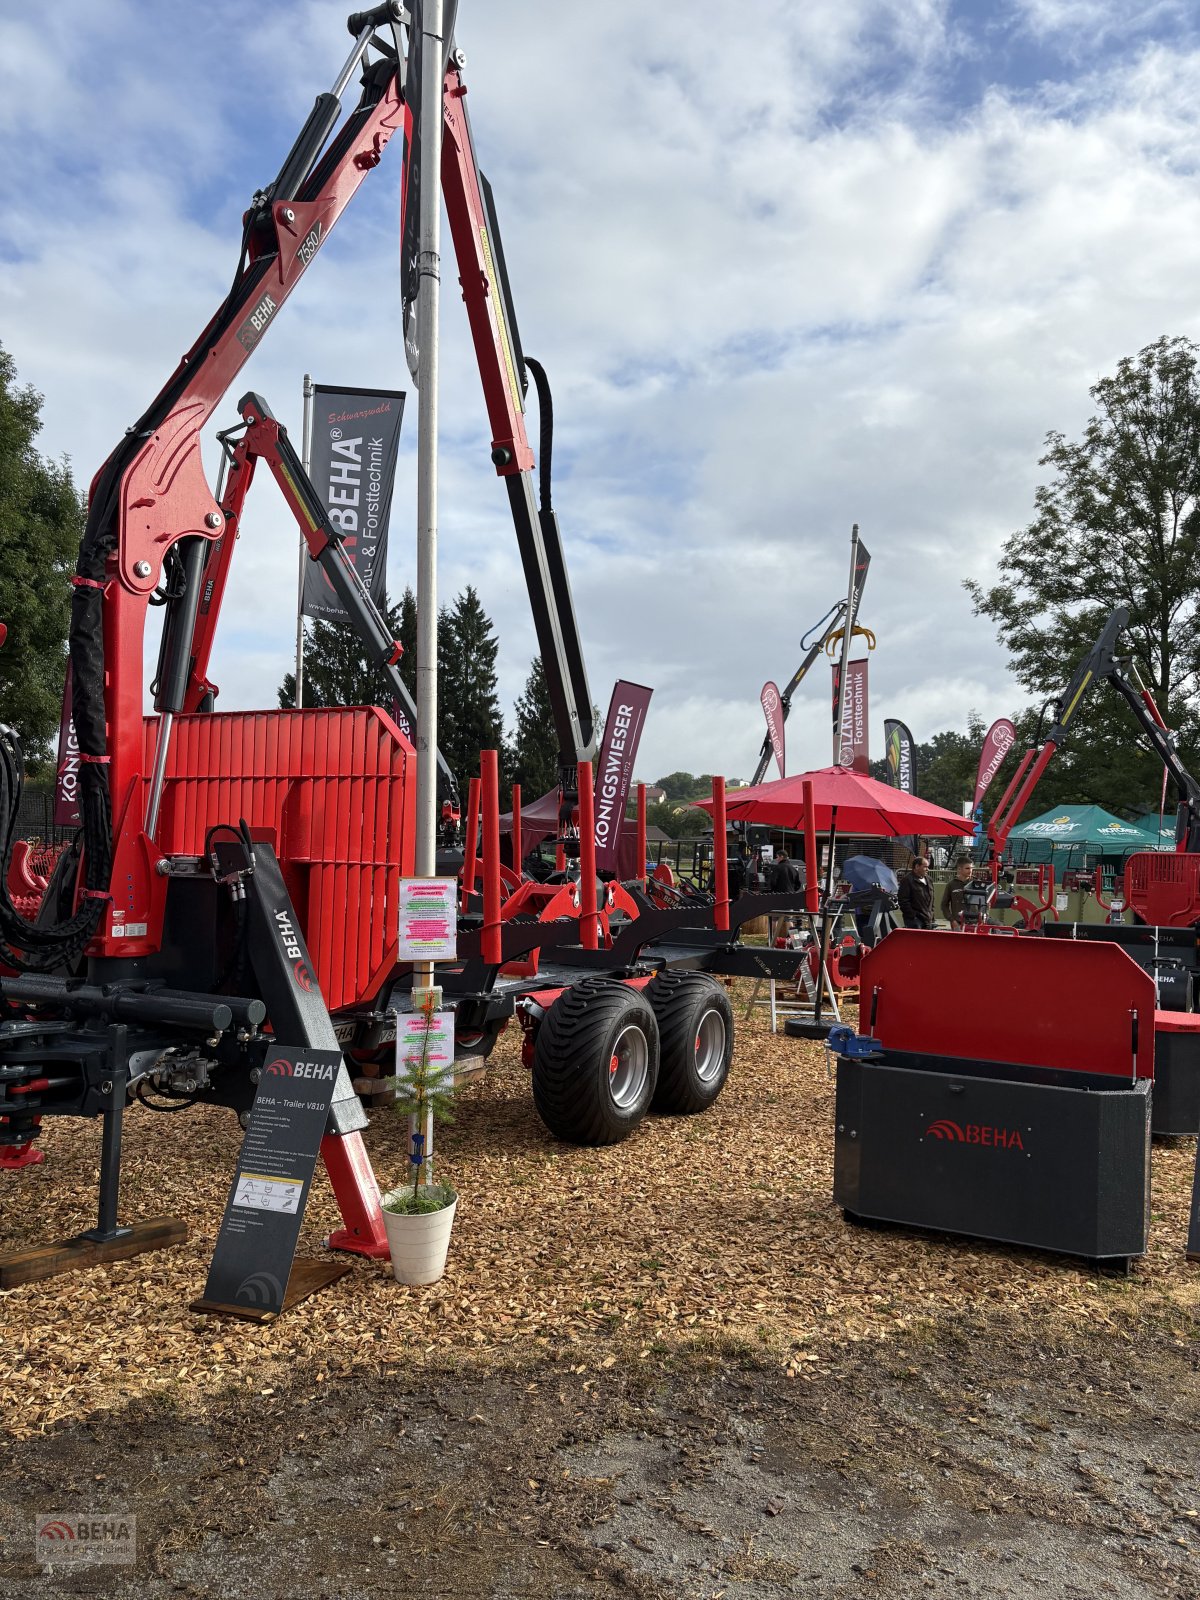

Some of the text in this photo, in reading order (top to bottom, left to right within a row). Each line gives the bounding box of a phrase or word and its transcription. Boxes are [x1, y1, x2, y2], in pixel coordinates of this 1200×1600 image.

[250, 296, 277, 332] BEHA
[327, 402, 391, 424] Schwarzwald
[362, 437, 383, 539] Forsttechnik
[361, 545, 376, 557] &
[204, 580, 214, 601] BEHA
[854, 672, 863, 745] Forsttechnik
[978, 734, 1015, 791] HOLZKNECHT
[276, 910, 302, 959] BEHA
[334, 1026, 353, 1040] EHA
[293, 1062, 333, 1080] BEHA
[256, 1097, 276, 1105] BEHA
[283, 1099, 305, 1109] Trailer
[306, 1102, 325, 1111] V810
[966, 1124, 1024, 1150] BEHA
